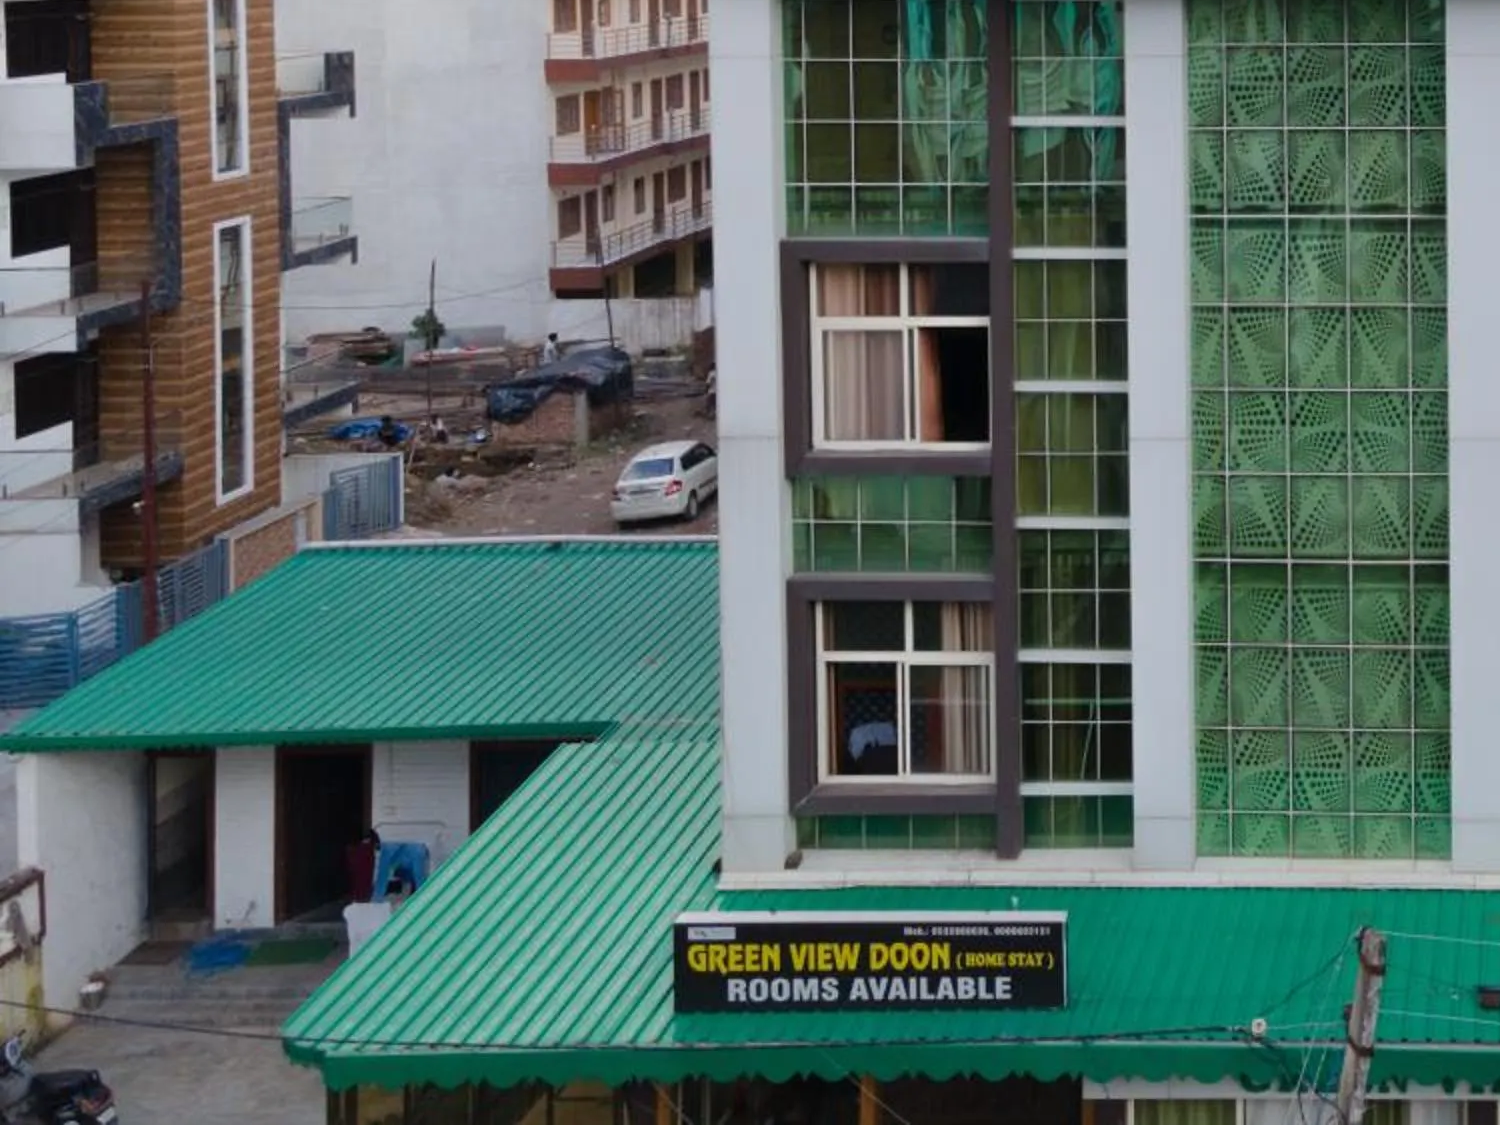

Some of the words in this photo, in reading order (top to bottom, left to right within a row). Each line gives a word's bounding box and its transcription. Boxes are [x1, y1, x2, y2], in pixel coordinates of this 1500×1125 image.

[687, 943, 781, 973] GREEN
[789, 942, 861, 971] VIEW
[869, 942, 951, 971] DOON
[727, 977, 840, 1003] ROOMS
[849, 976, 1012, 1001] AVAILABLE
